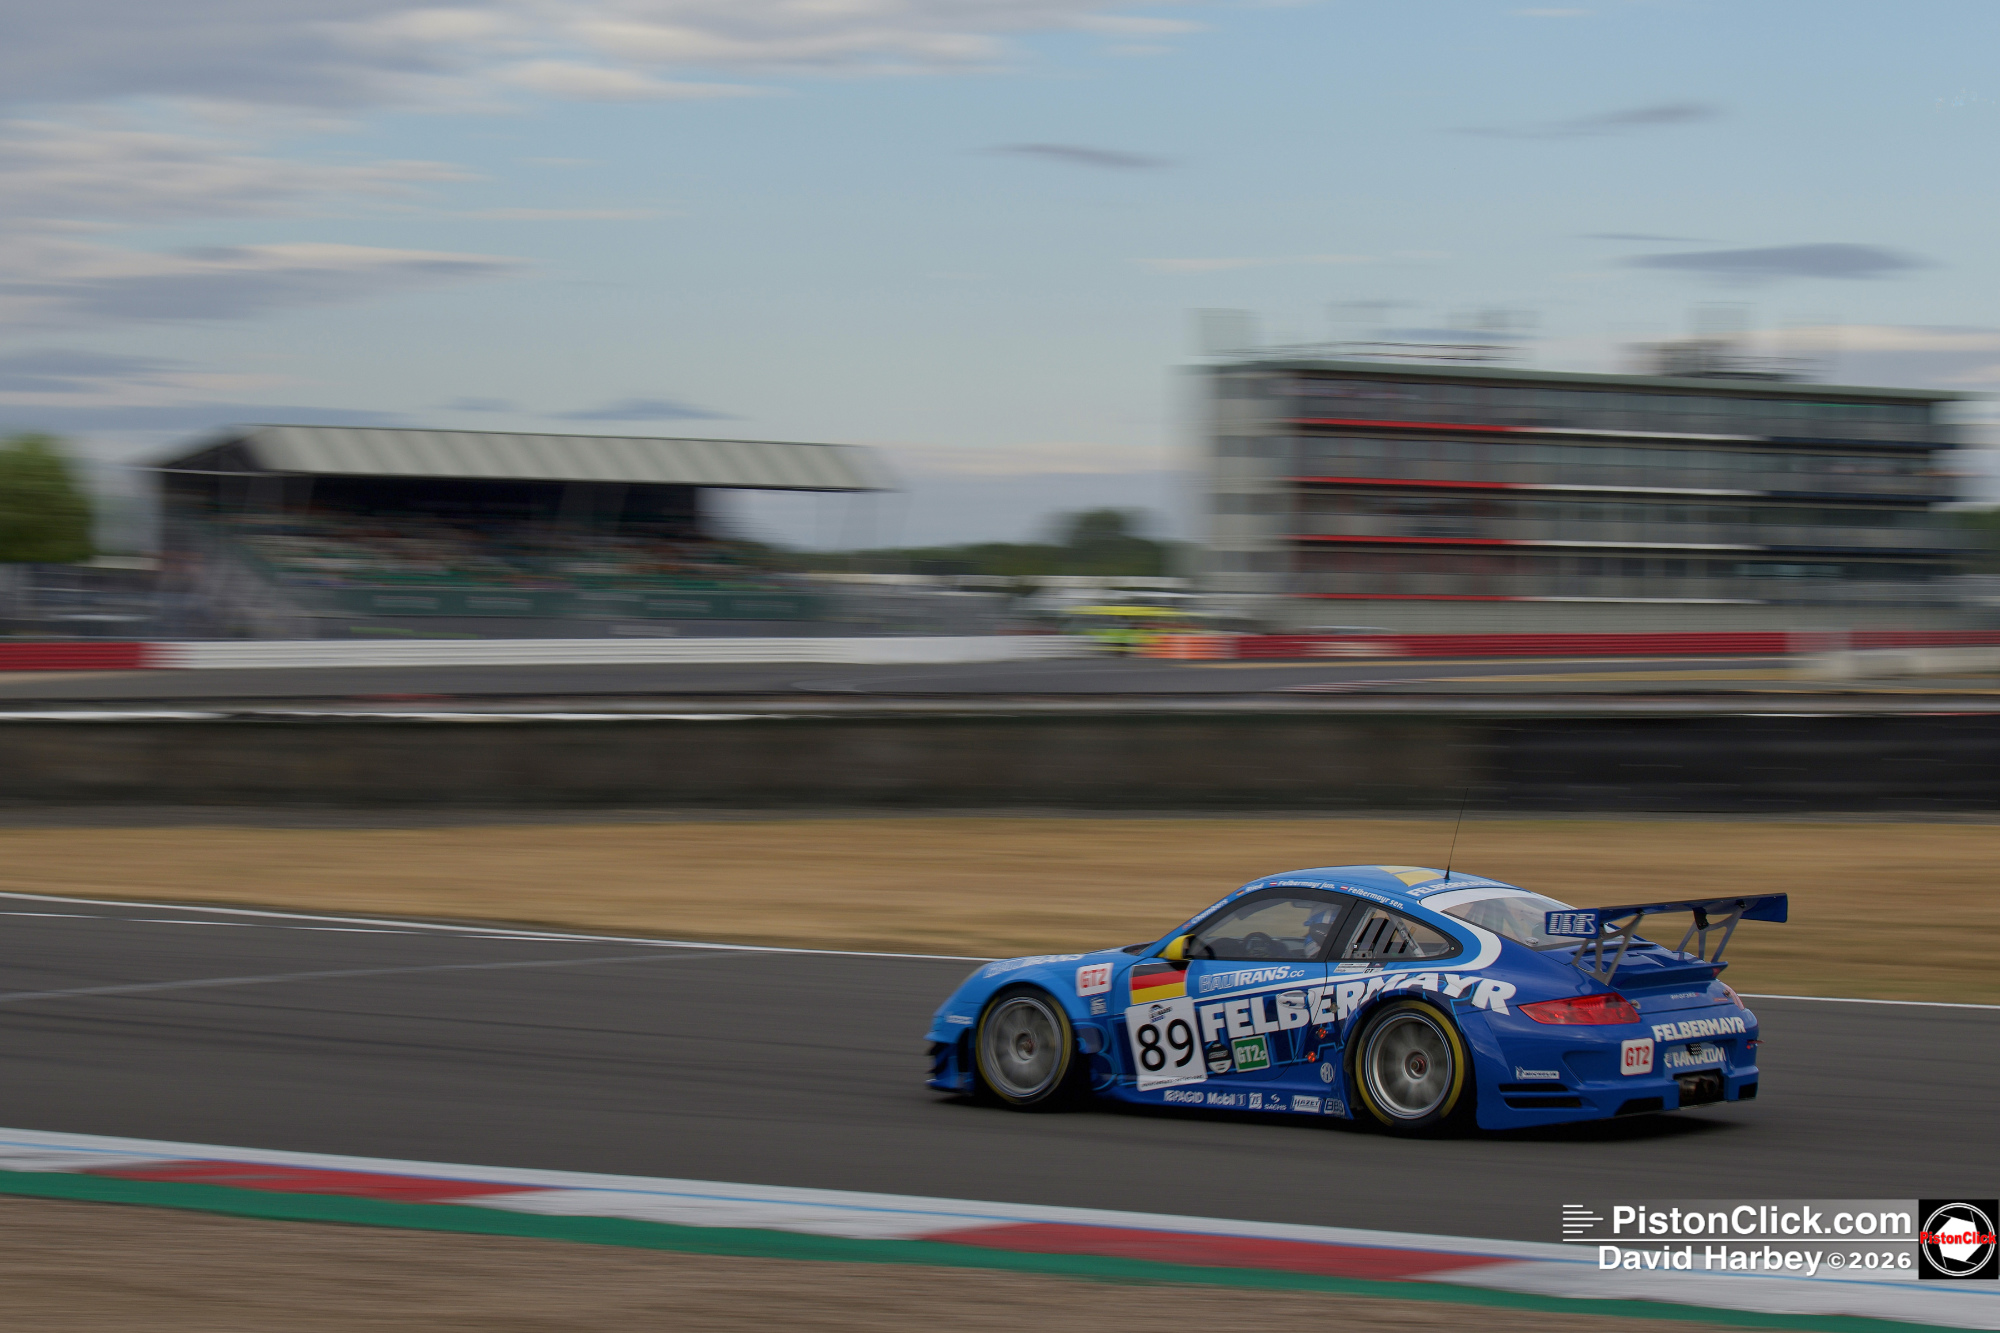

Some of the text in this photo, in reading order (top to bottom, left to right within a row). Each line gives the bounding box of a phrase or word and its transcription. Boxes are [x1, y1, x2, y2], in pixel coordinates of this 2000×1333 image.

[1347, 887, 1404, 910] Felbermayr sen.
[1080, 968, 1108, 989] GT2
[1200, 972, 1517, 1042] FELBERMAYR
[1651, 1016, 1746, 1043] FELBERMAYR
[1138, 1018, 1194, 1072] 89
[1625, 1045, 1650, 1067] GT2
[1206, 1091, 1236, 1106] Mobil
